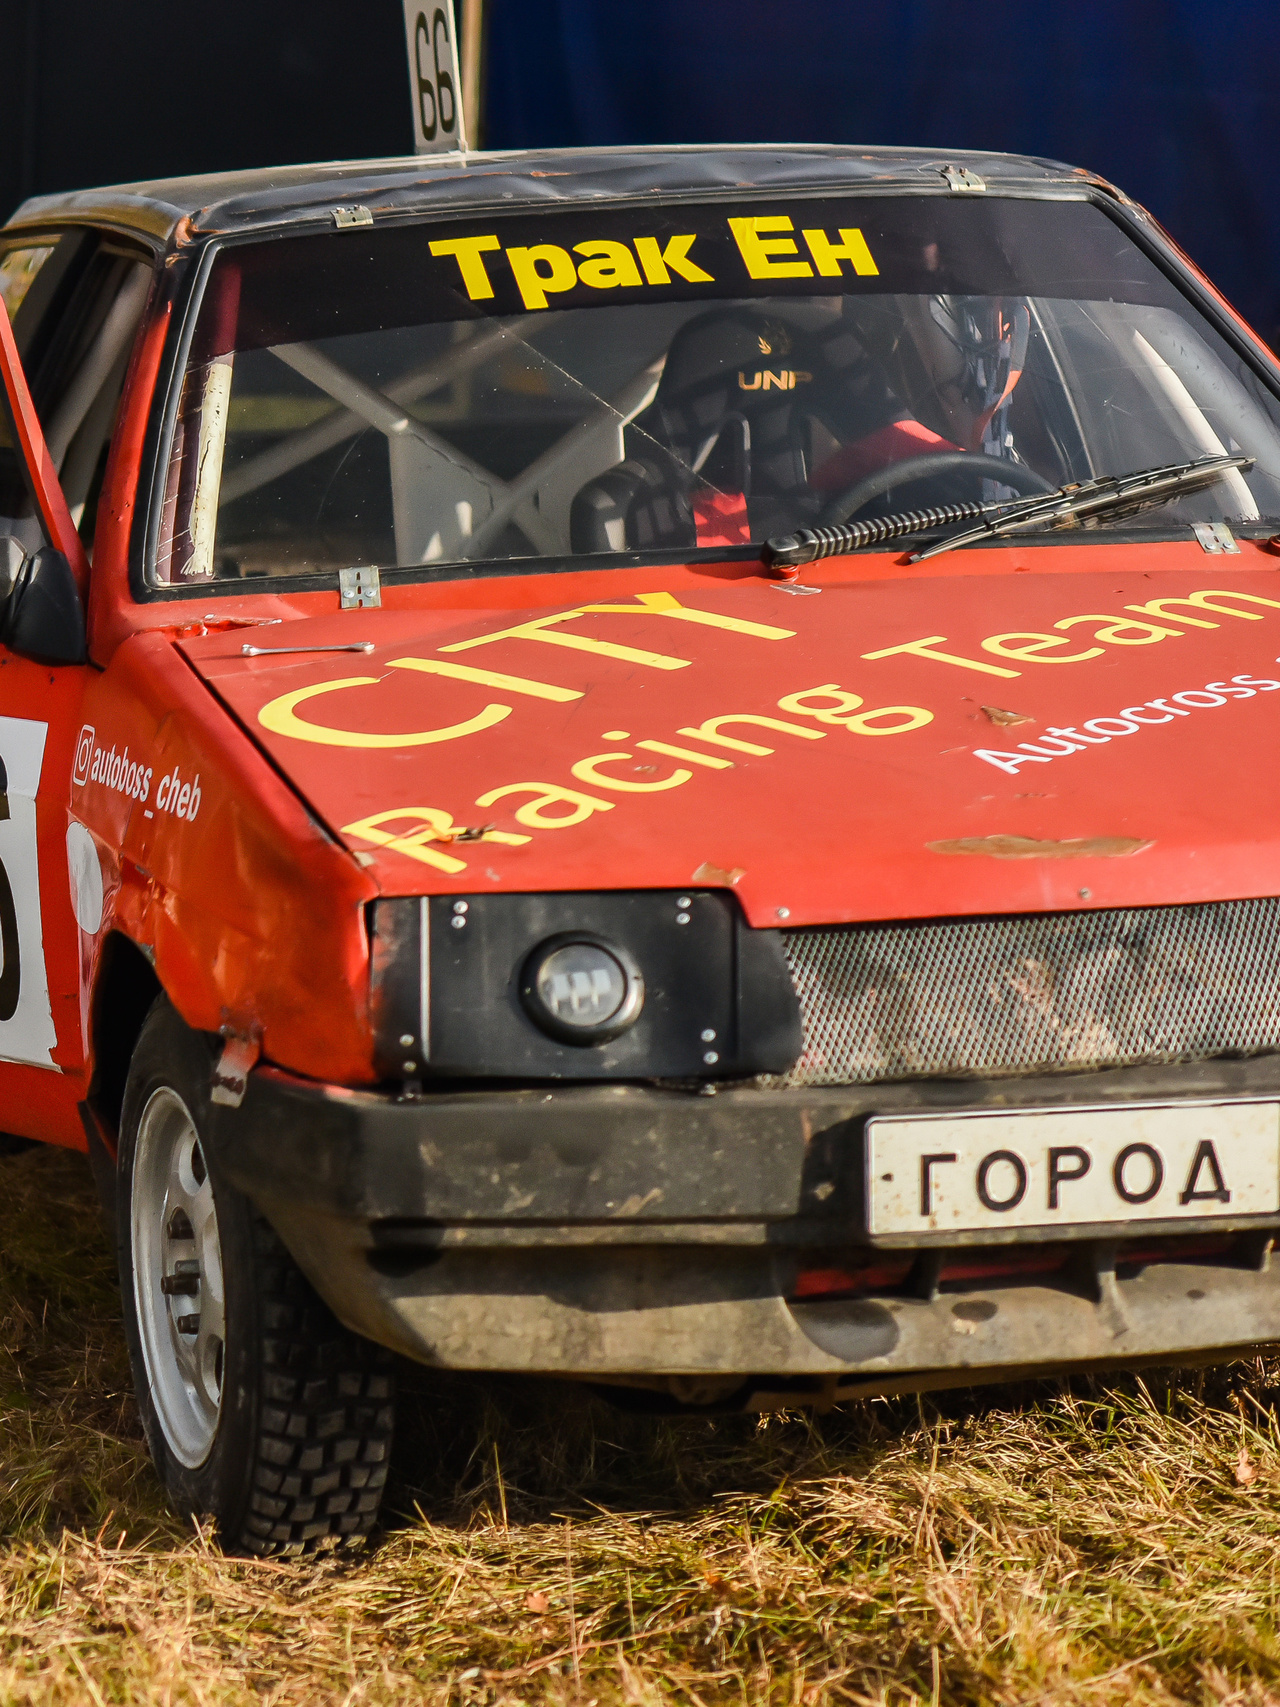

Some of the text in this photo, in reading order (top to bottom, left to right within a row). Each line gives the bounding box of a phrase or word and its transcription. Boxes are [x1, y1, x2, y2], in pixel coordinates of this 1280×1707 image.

[415, 8, 456, 141] 66
[428, 216, 880, 310] Трак Ен
[257, 591, 798, 748] CITY
[340, 589, 1280, 874] Racing Team
[973, 674, 1280, 775] Autocross
[91, 744, 202, 822] autoboss_cheb
[920, 1139, 1232, 1217] ГОРОД
